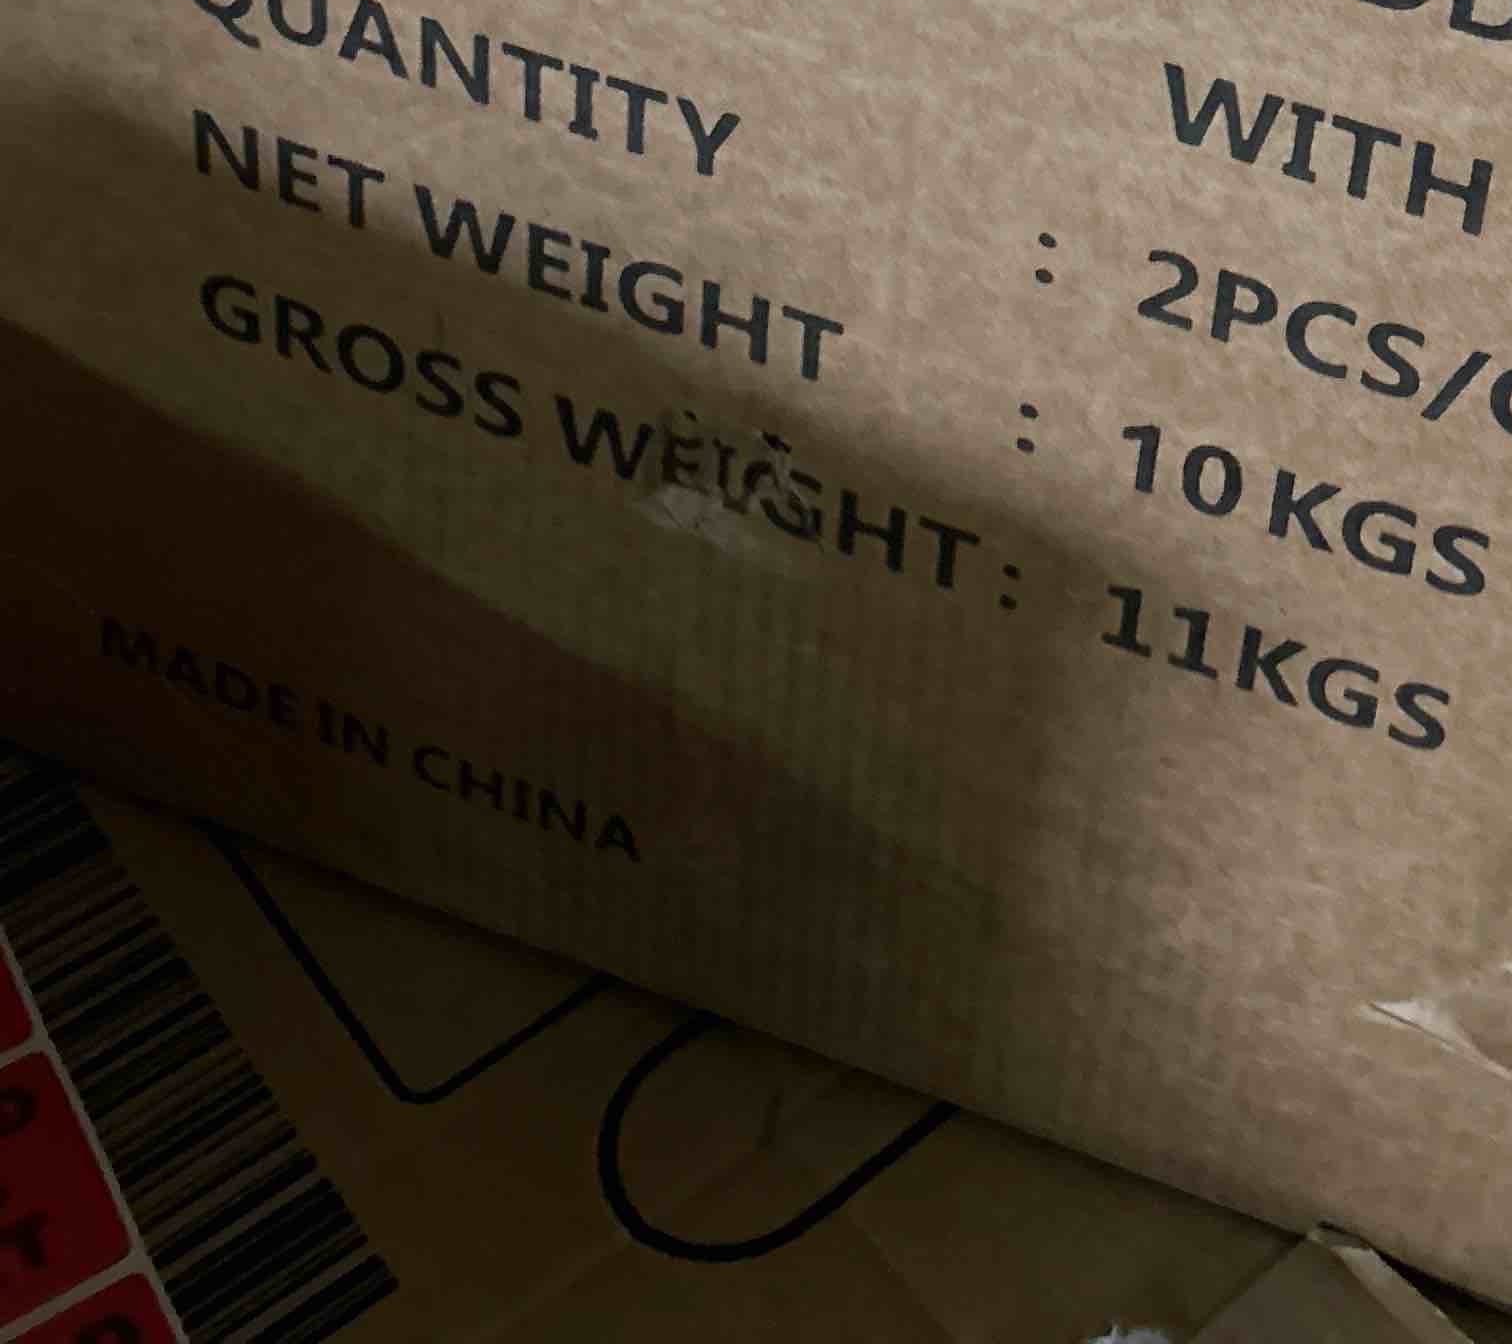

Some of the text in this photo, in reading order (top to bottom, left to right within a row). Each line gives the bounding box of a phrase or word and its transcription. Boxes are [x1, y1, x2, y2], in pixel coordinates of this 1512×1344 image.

[1164, 63, 1493, 236] WITH
[194, 110, 384, 229] NET
[414, 184, 844, 380] WEIGHT
[1123, 425, 1242, 516] 10
[1269, 469, 1489, 595] KGS
[200, 276, 522, 438] GROSS
[1102, 584, 1449, 750] 11KGS
[100, 616, 640, 863] MADE IN CHINA
